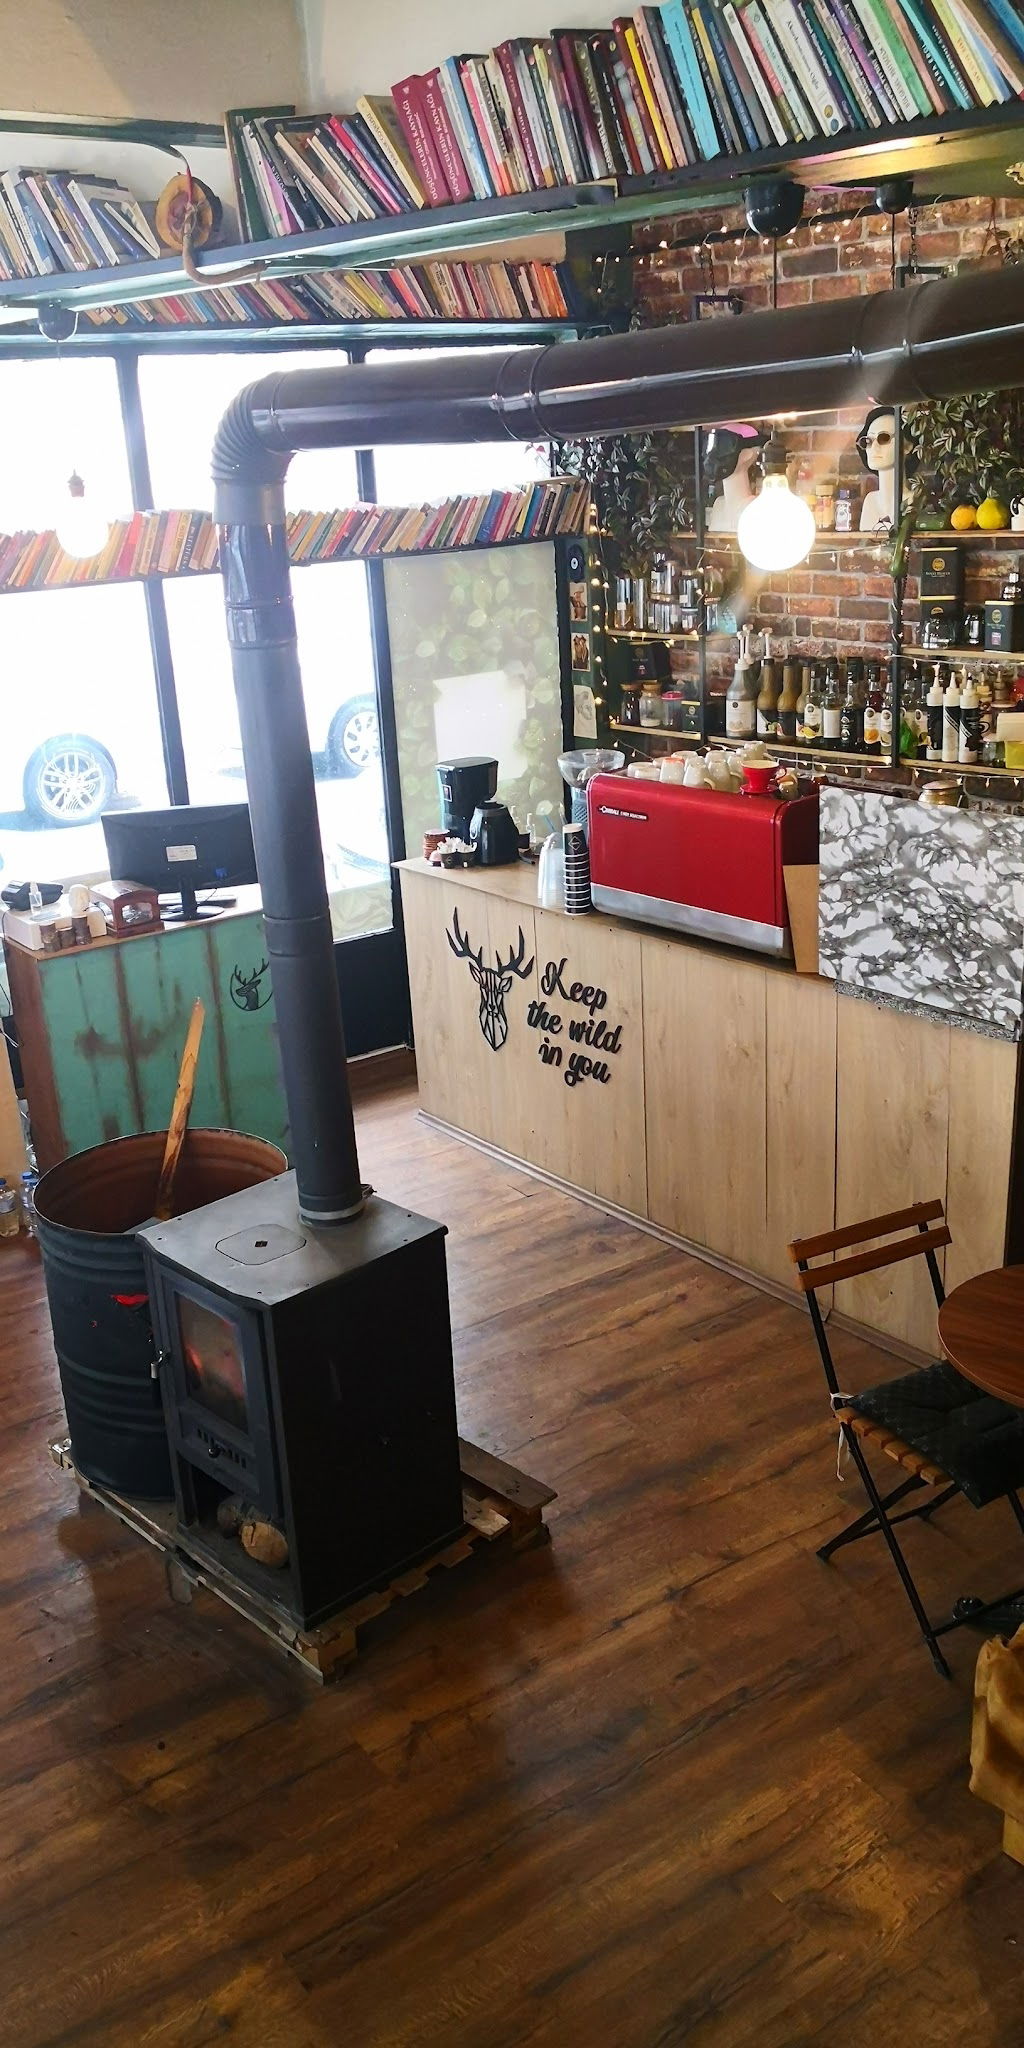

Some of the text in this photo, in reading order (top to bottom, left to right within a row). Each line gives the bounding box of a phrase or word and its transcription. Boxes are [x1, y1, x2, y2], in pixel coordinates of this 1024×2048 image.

[402, 99, 418, 138] KAYNAĞI
[426, 93, 442, 132] KAYNAĞI
[414, 137, 438, 200] DÜŞÜNCELERİN
[541, 957, 607, 1016] Keep
[527, 1000, 623, 1054] the wild
[538, 1037, 611, 1087] in you
